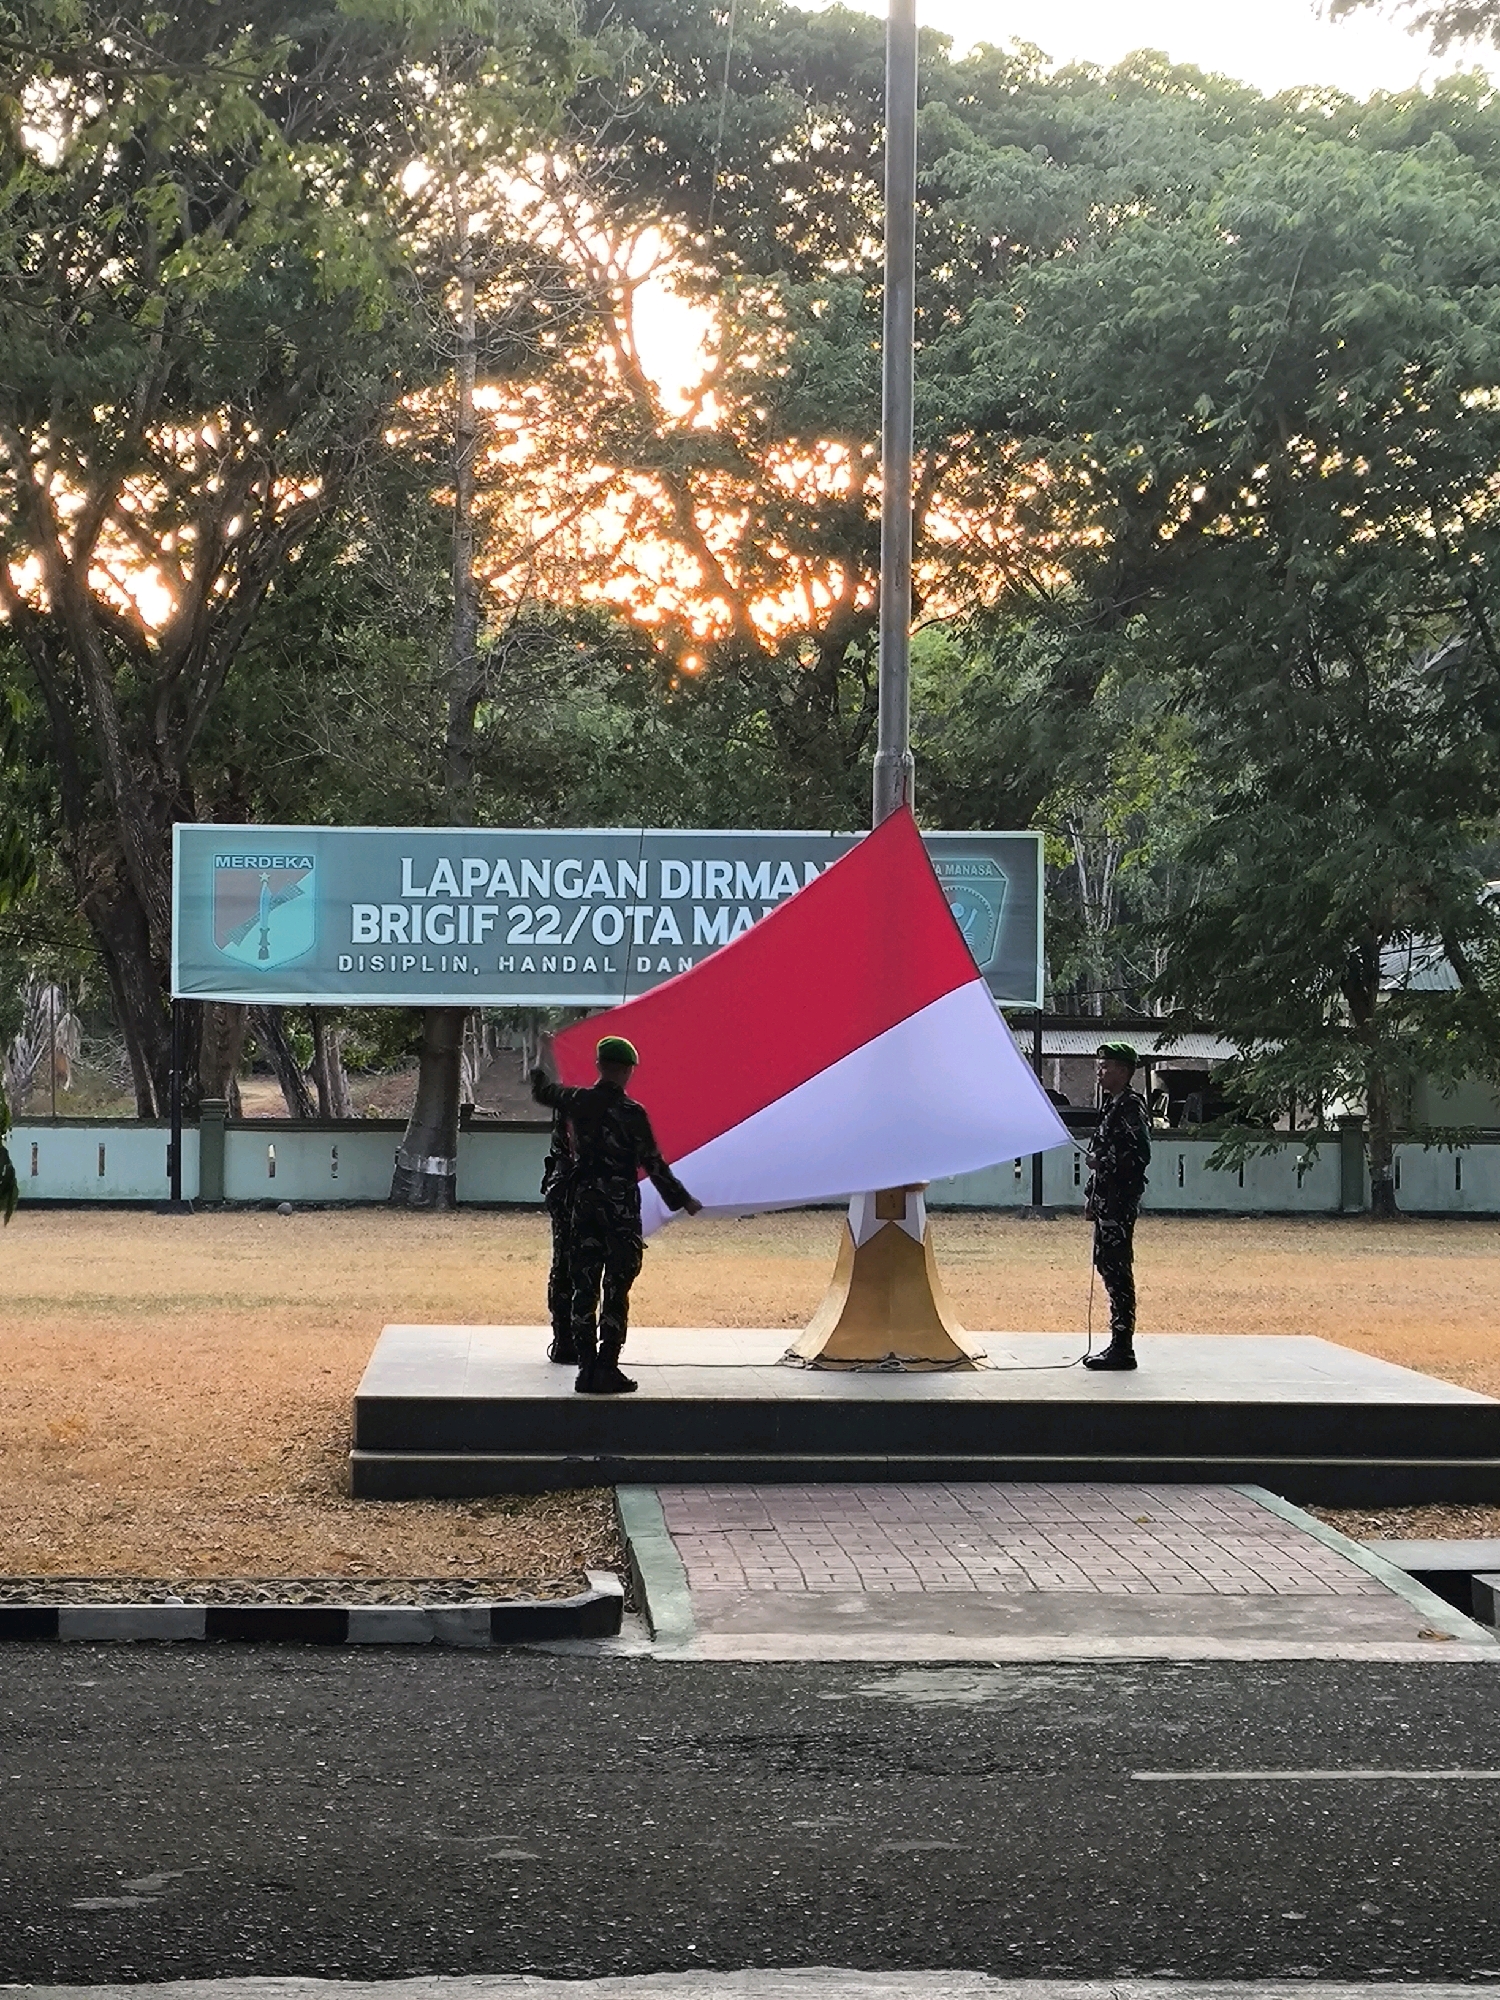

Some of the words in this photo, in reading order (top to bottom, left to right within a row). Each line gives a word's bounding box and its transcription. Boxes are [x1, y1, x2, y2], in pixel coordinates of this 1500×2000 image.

[215, 856, 313, 869] MERDEKA
[944, 864, 994, 876] MANASA
[401, 857, 648, 900] LAPANGAN
[351, 903, 499, 945] BRIGIF
[506, 905, 684, 945] 22/OTA
[693, 905, 774, 946] MA
[338, 954, 480, 976] DISIPLIN,
[498, 955, 617, 973] HANDAL
[636, 956, 694, 973] DAN
